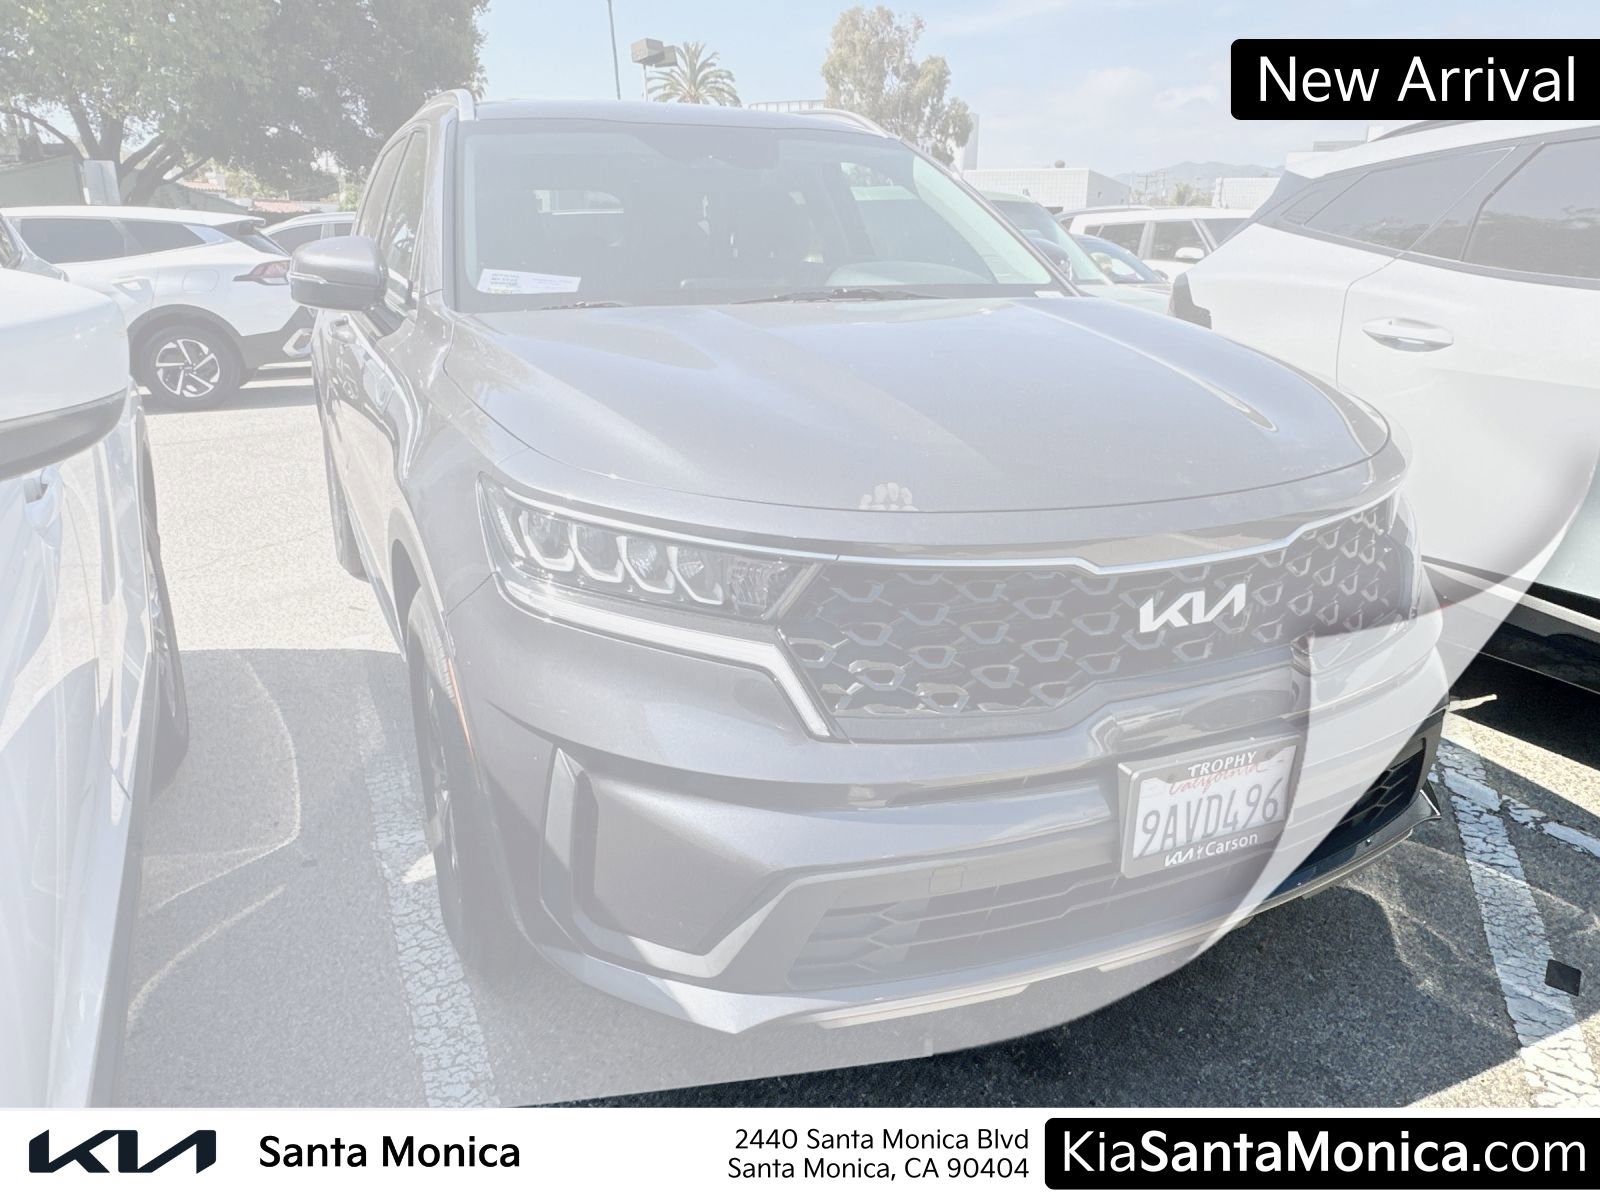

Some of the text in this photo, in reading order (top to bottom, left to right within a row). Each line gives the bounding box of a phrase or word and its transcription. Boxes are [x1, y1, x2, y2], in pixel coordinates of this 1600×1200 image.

[1139, 583, 1247, 634] KIA
[1187, 751, 1257, 778] TROPHY
[1138, 776, 1285, 858] 9AVD496
[1205, 833, 1258, 857] Carson
